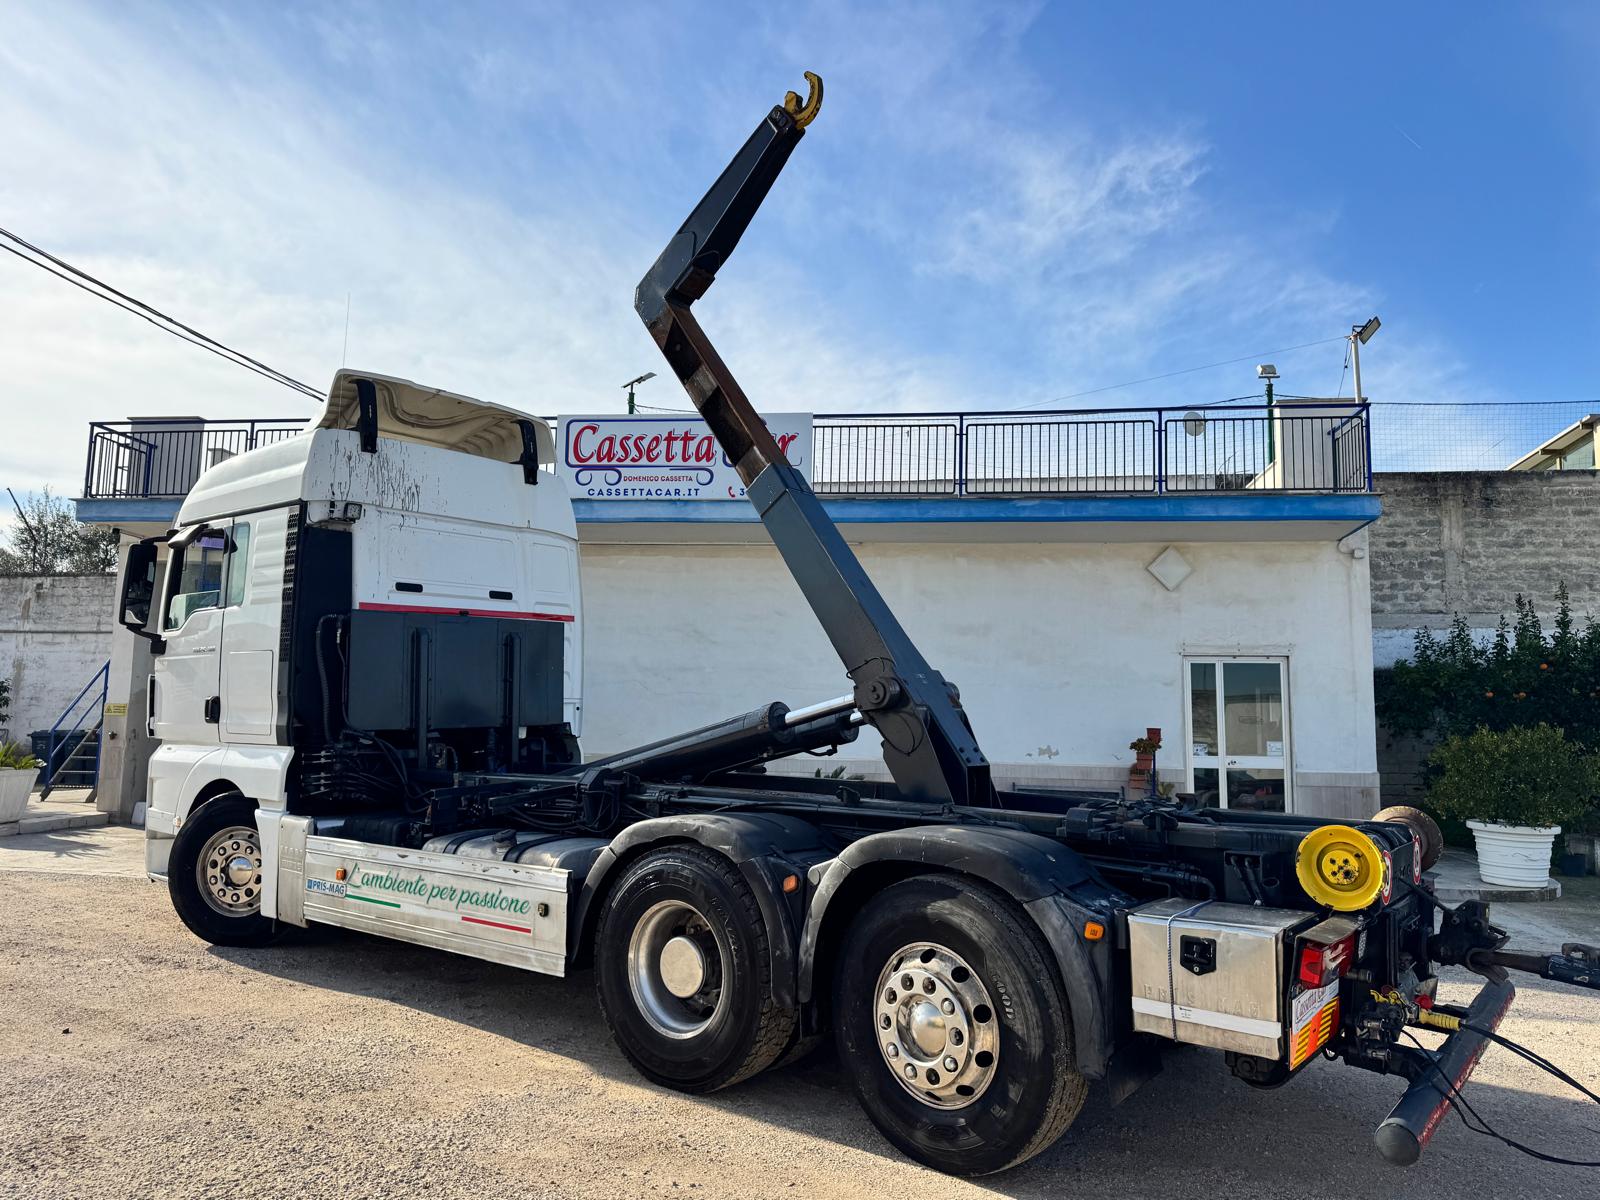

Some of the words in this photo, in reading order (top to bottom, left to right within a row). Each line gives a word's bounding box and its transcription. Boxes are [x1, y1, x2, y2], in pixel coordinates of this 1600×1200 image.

[572, 423, 716, 465] Cassetta
[587, 488, 700, 496] CASSETTACAR.IT
[312, 880, 345, 895] PRIS-MAG
[346, 862, 428, 896] L'ambiente
[426, 884, 457, 905] per
[455, 887, 531, 915] passione
